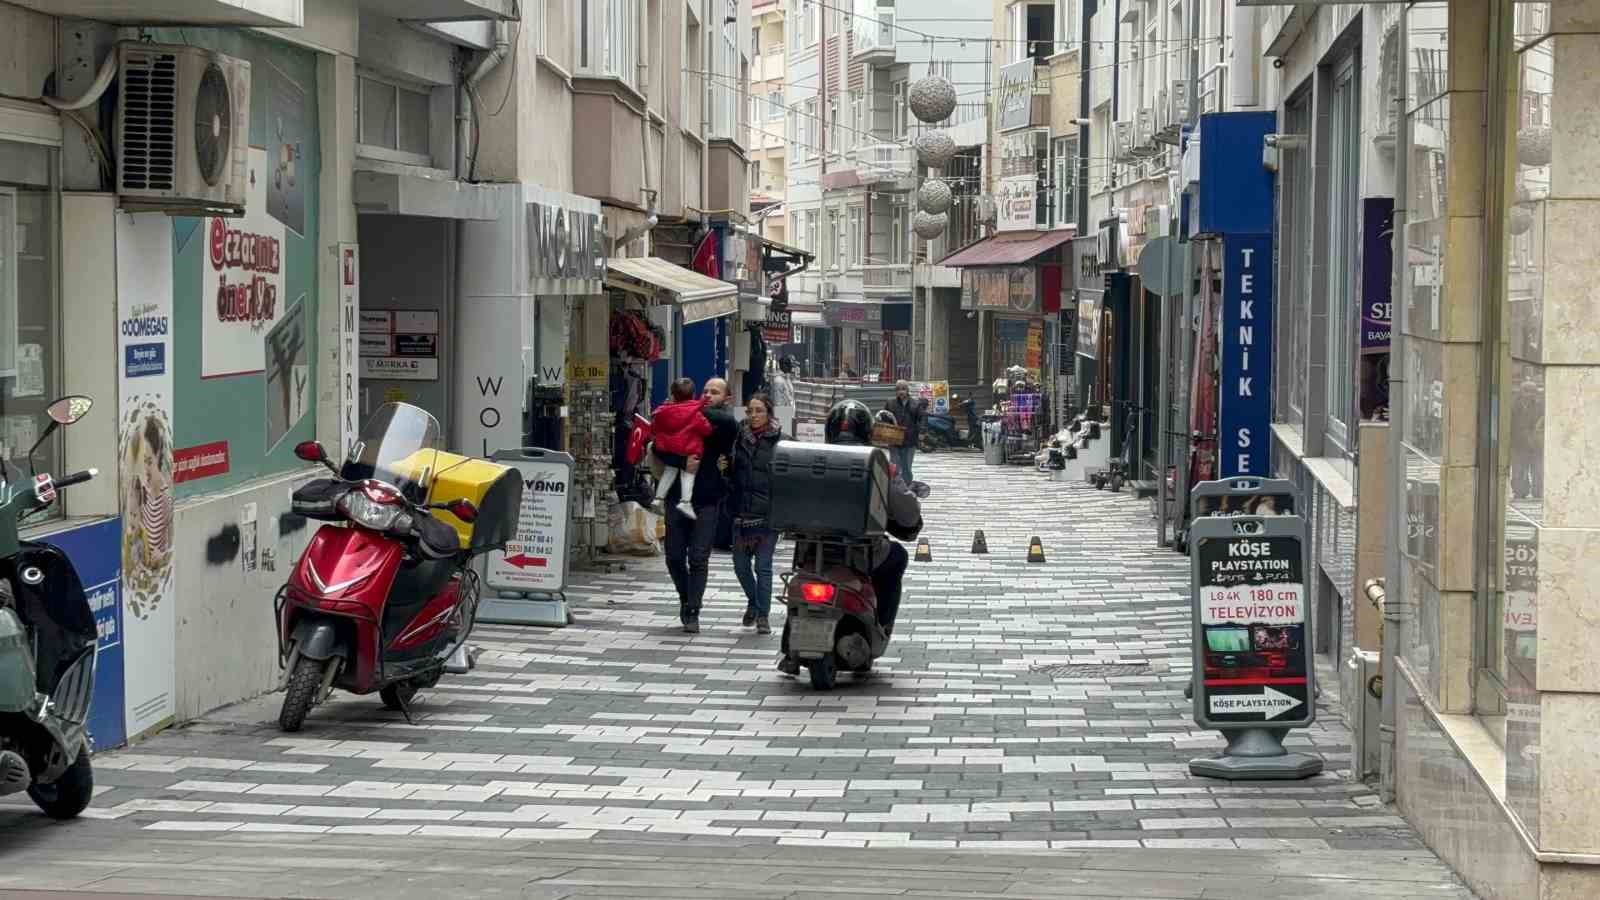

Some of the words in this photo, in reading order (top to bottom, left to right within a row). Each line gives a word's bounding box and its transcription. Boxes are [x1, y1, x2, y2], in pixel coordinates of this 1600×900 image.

[1239, 248, 1254, 397] TEKNİK
[1228, 539, 1271, 558] KÖŞE
[1211, 559, 1290, 571] PLAYSTATION
[1210, 591, 1225, 601] LG
[1226, 591, 1241, 601] 4K
[1249, 589, 1274, 602] 180
[1277, 591, 1297, 601] cm
[1209, 604, 1296, 619] TELEVİZYON
[1236, 699, 1292, 708] PLAYSTATION
